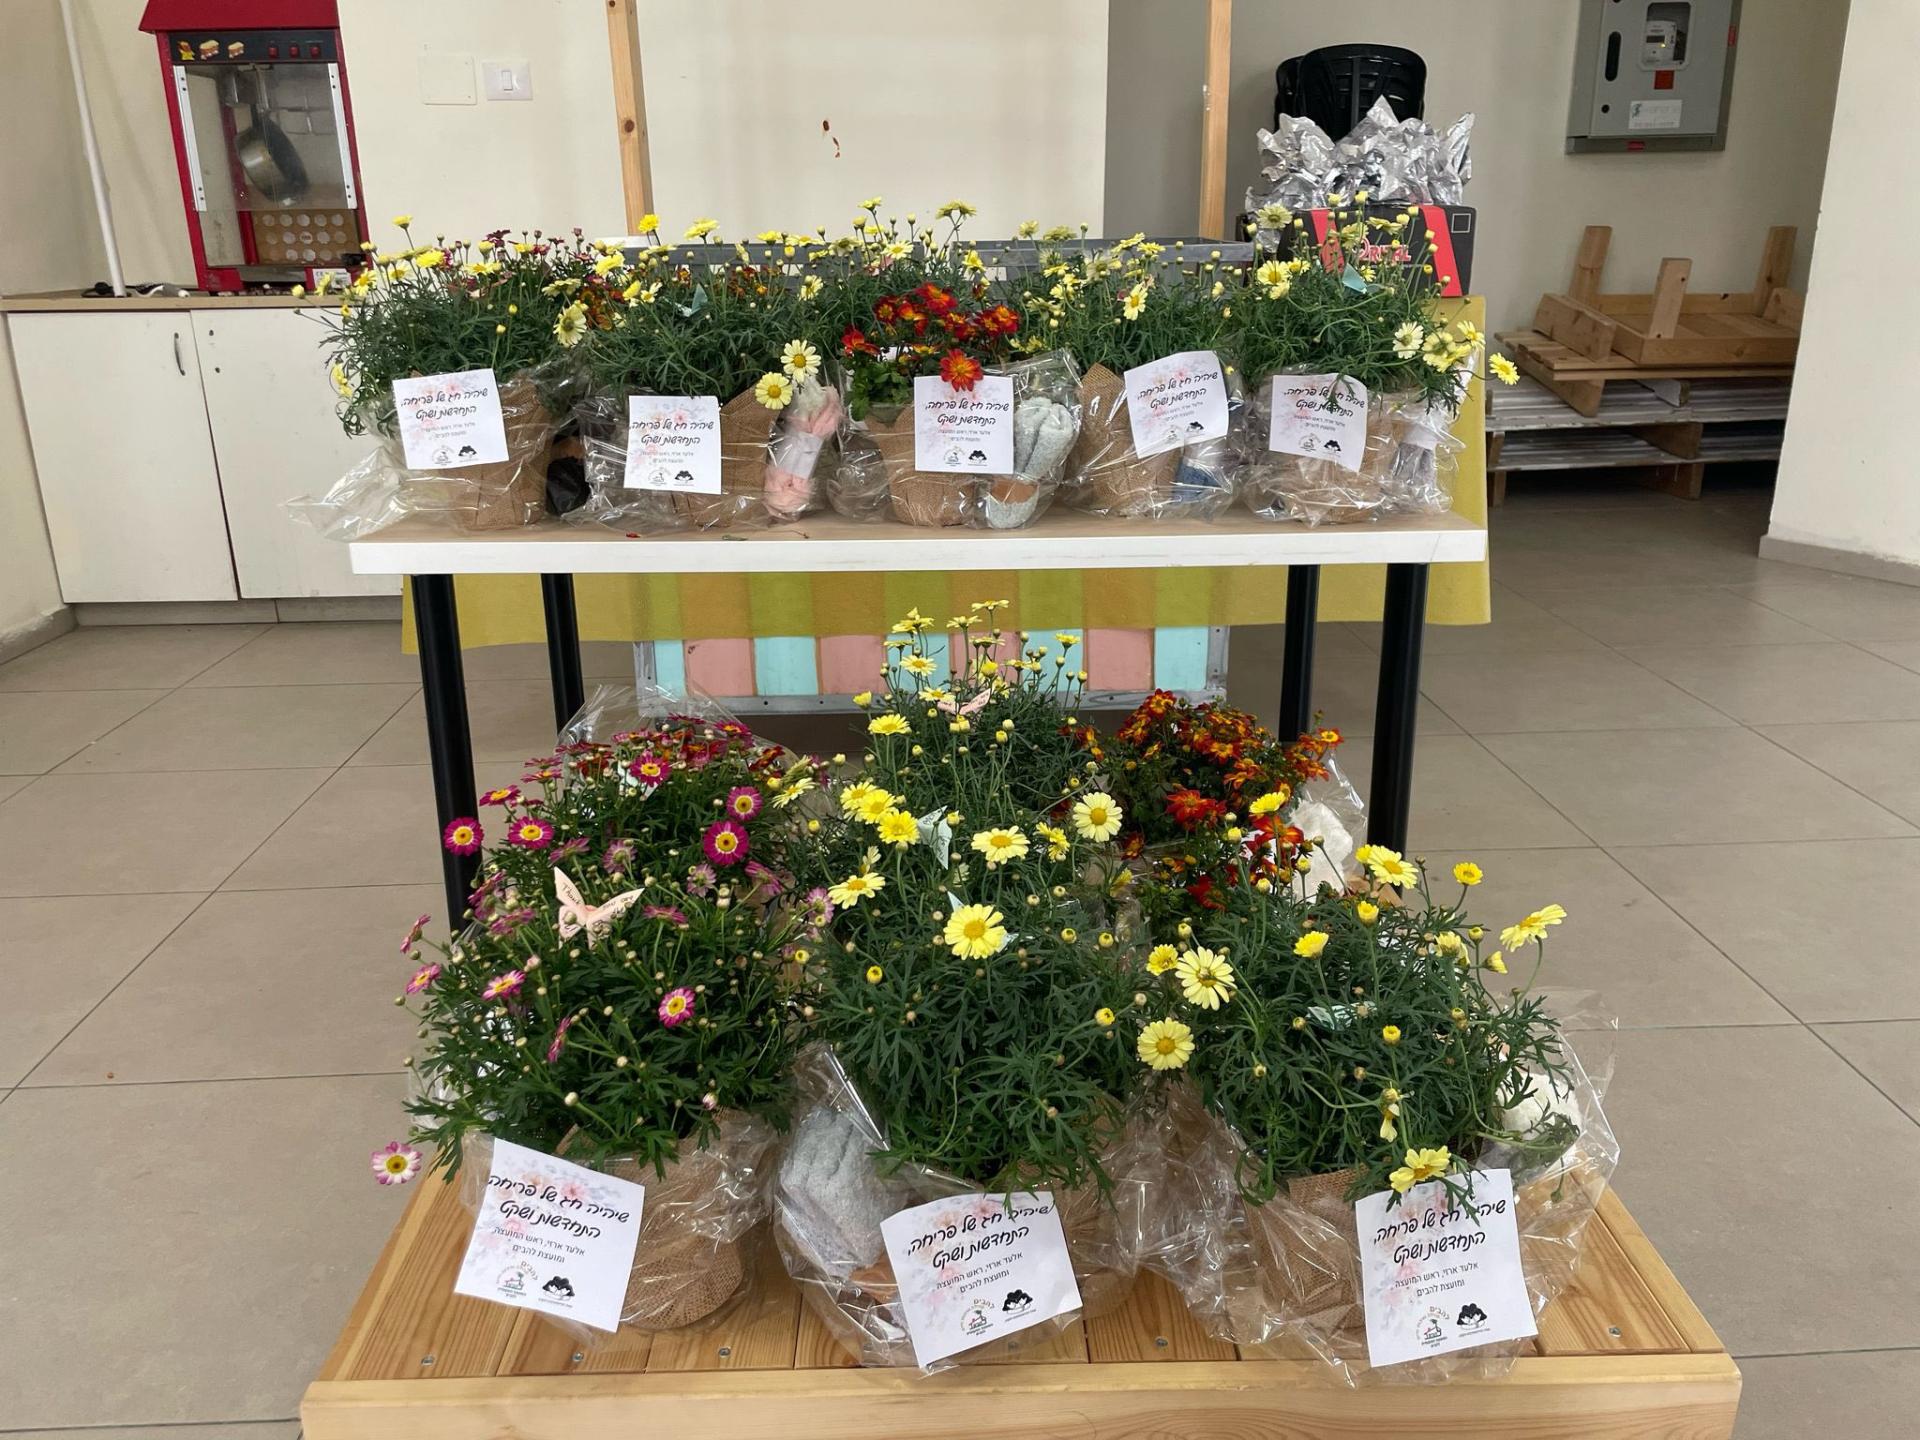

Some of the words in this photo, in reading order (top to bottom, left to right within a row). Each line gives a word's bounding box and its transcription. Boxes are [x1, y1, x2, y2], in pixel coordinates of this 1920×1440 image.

[1168, 378, 1176, 389] של
[1179, 378, 1191, 388] חג
[1194, 372, 1218, 383] שיהיה
[436, 391, 446, 402] של
[448, 393, 461, 403] חג
[464, 388, 488, 400] שיהיה
[1319, 386, 1330, 398] של
[958, 398, 968, 409] של
[970, 402, 983, 410] חג
[986, 402, 1009, 411] שיהיה
[662, 418, 672, 429] של
[674, 422, 687, 430] חג
[690, 422, 714, 430] שיהיה
[540, 1186, 557, 1202] של
[559, 1195, 582, 1210] חג
[500, 1200, 535, 1220] ושקט
[587, 1203, 630, 1223] שיהיה
[1465, 1200, 1506, 1220] שיהי
[962, 1214, 977, 1234] של
[981, 1213, 1002, 1229] חג
[1422, 1208, 1436, 1229] של
[1440, 1210, 1460, 1227] חג
[530, 1214, 600, 1238] התחדשות
[1374, 1218, 1418, 1244] פריחה,
[494, 1226, 524, 1240] המועצה
[526, 1234, 544, 1246] ראש
[908, 1225, 957, 1256] פריחה,
[966, 1226, 1030, 1262] התחדשות
[512, 1244, 536, 1257] להבים
[564, 1244, 585, 1256] אלעד
[1423, 1232, 1486, 1262] התחדשות
[933, 1247, 964, 1270] ושקט
[1004, 1252, 1023, 1264] אלעד
[1394, 1245, 1423, 1266] ושקט
[966, 1267, 984, 1279] ראש
[1460, 1262, 1479, 1272] אלעד
[936, 1274, 964, 1290] המועצה
[984, 1270, 1010, 1284] ומועצת
[1395, 1275, 1422, 1288] המועצה
[1424, 1270, 1440, 1282] ראש
[960, 1280, 982, 1294] להבים
[1416, 1284, 1439, 1297] להבים
